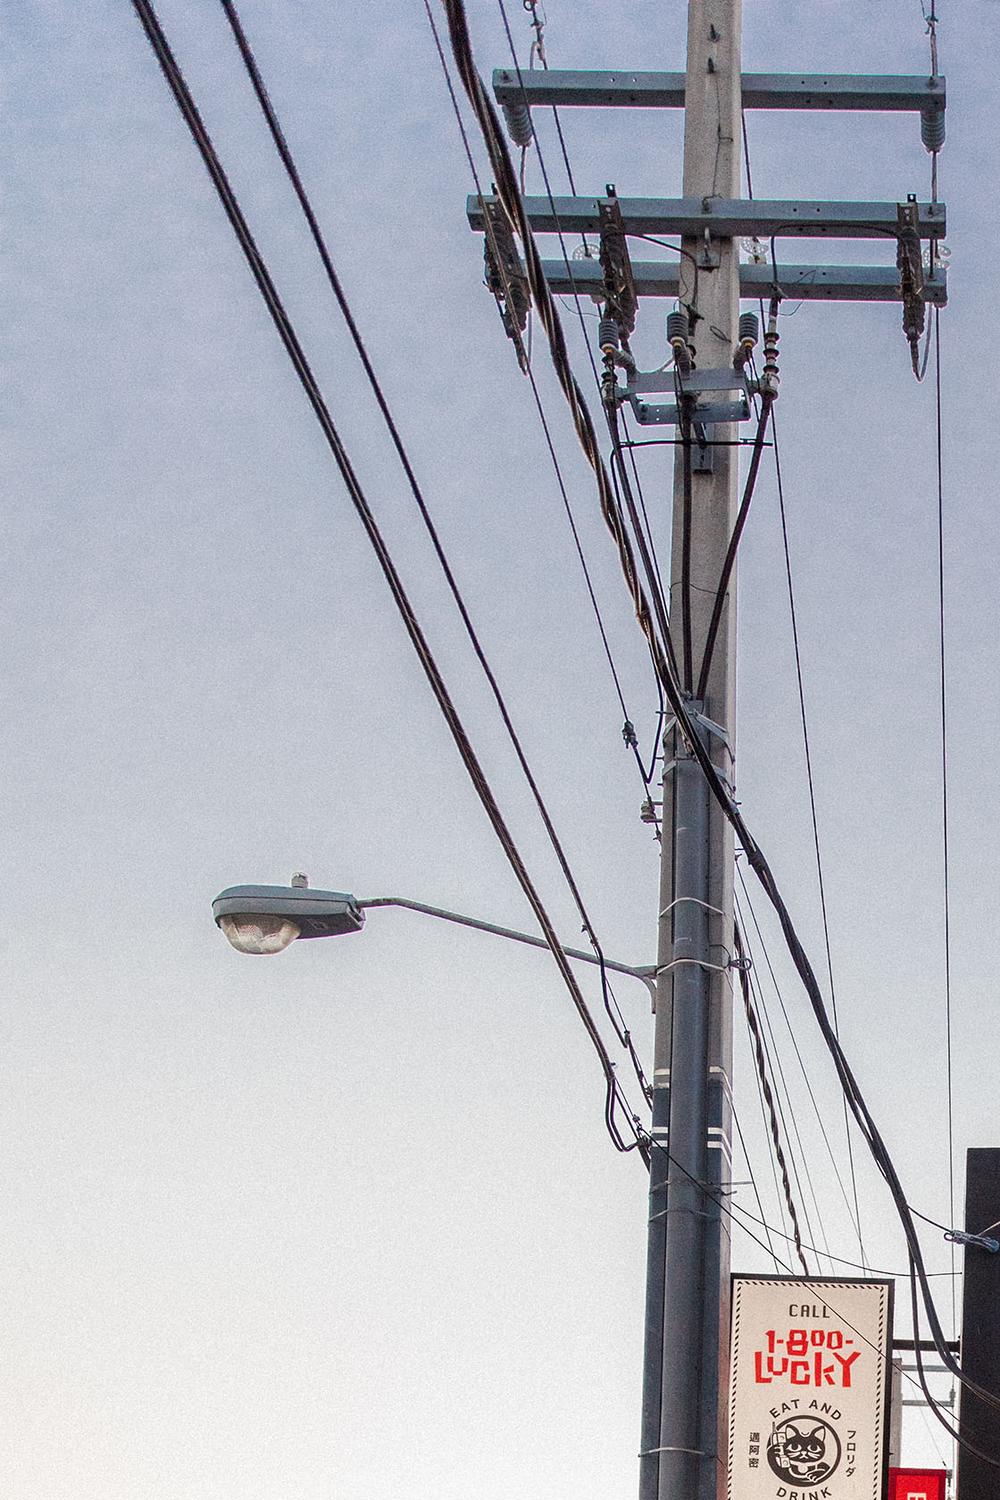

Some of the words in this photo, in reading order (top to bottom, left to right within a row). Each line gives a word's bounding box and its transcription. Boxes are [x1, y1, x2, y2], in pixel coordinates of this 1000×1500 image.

[788, 1303, 831, 1319] CALL
[765, 1329, 855, 1356] 1-800-
[769, 1398, 801, 1420] EAT
[808, 1399, 842, 1421] AND
[845, 1430, 856, 1478] フロリダ
